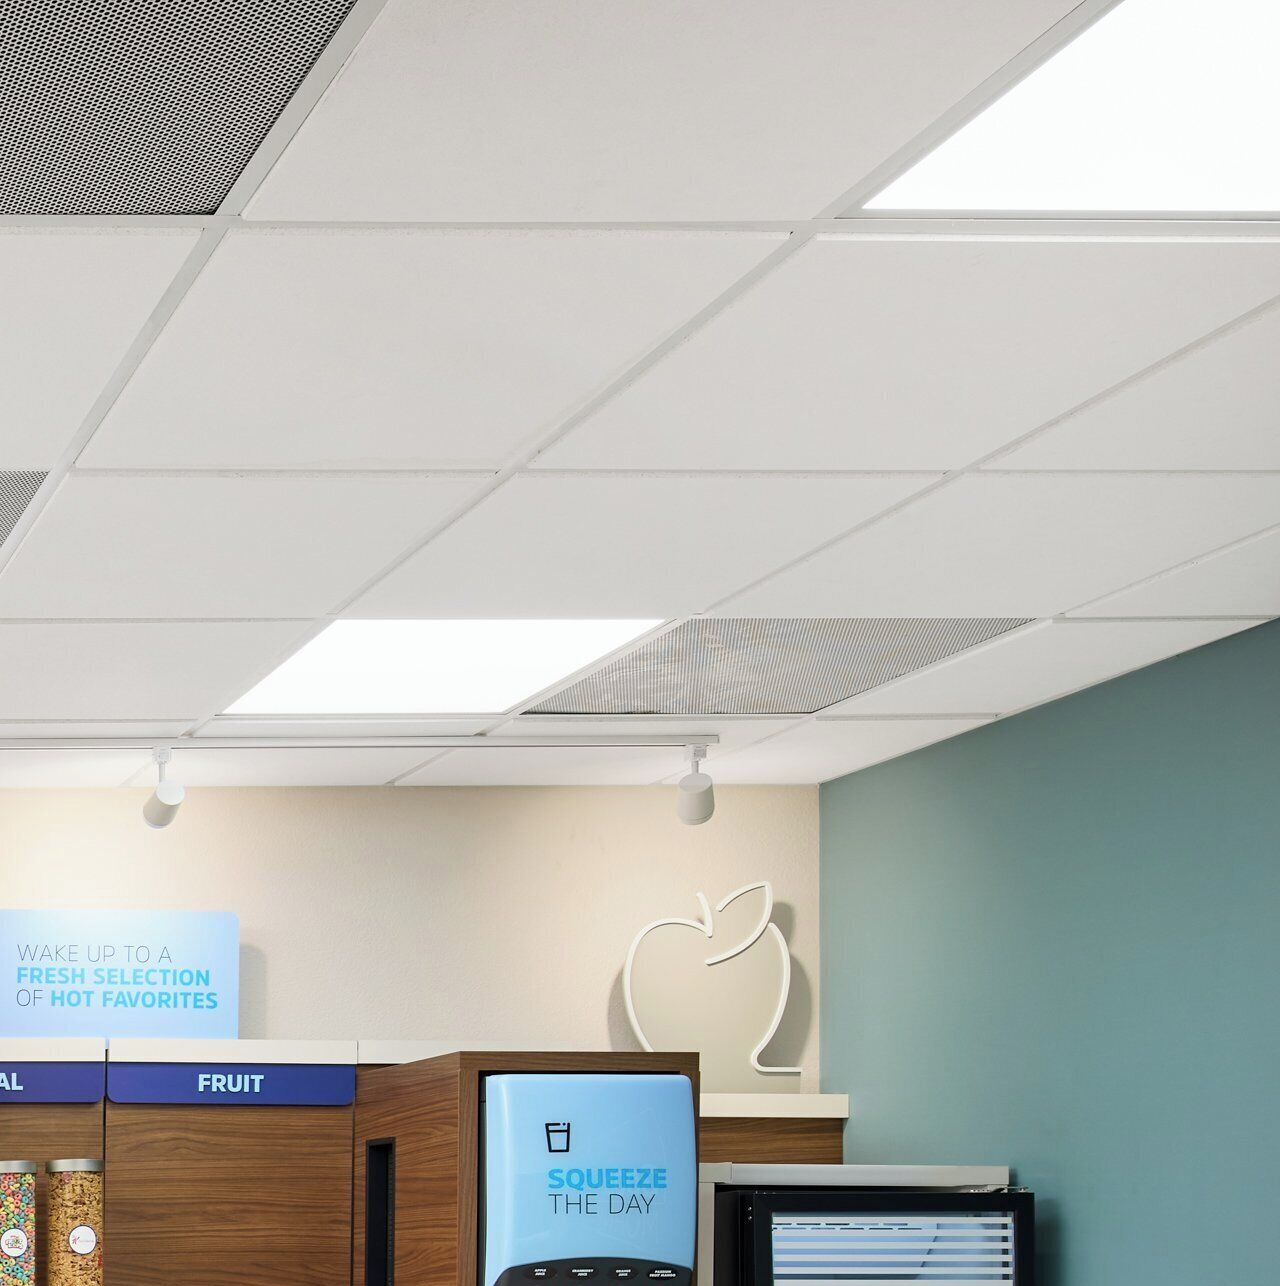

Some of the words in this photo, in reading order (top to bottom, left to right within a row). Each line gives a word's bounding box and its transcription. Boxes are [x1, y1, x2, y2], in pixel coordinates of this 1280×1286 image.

[17, 943, 79, 963] WAKE
[87, 944, 116, 963] UP
[123, 944, 151, 964] TO
[158, 945, 173, 964] A
[16, 966, 86, 985] FRESH
[93, 967, 210, 987] SELECTION
[16, 988, 44, 1007] OF
[50, 989, 94, 1008] HOT
[102, 990, 219, 1010] FAVORITES
[197, 1073, 265, 1093] FRUIT
[547, 1168, 668, 1191] SQUEEZE
[547, 1193, 598, 1214] THE
[609, 1193, 656, 1214] DAY
